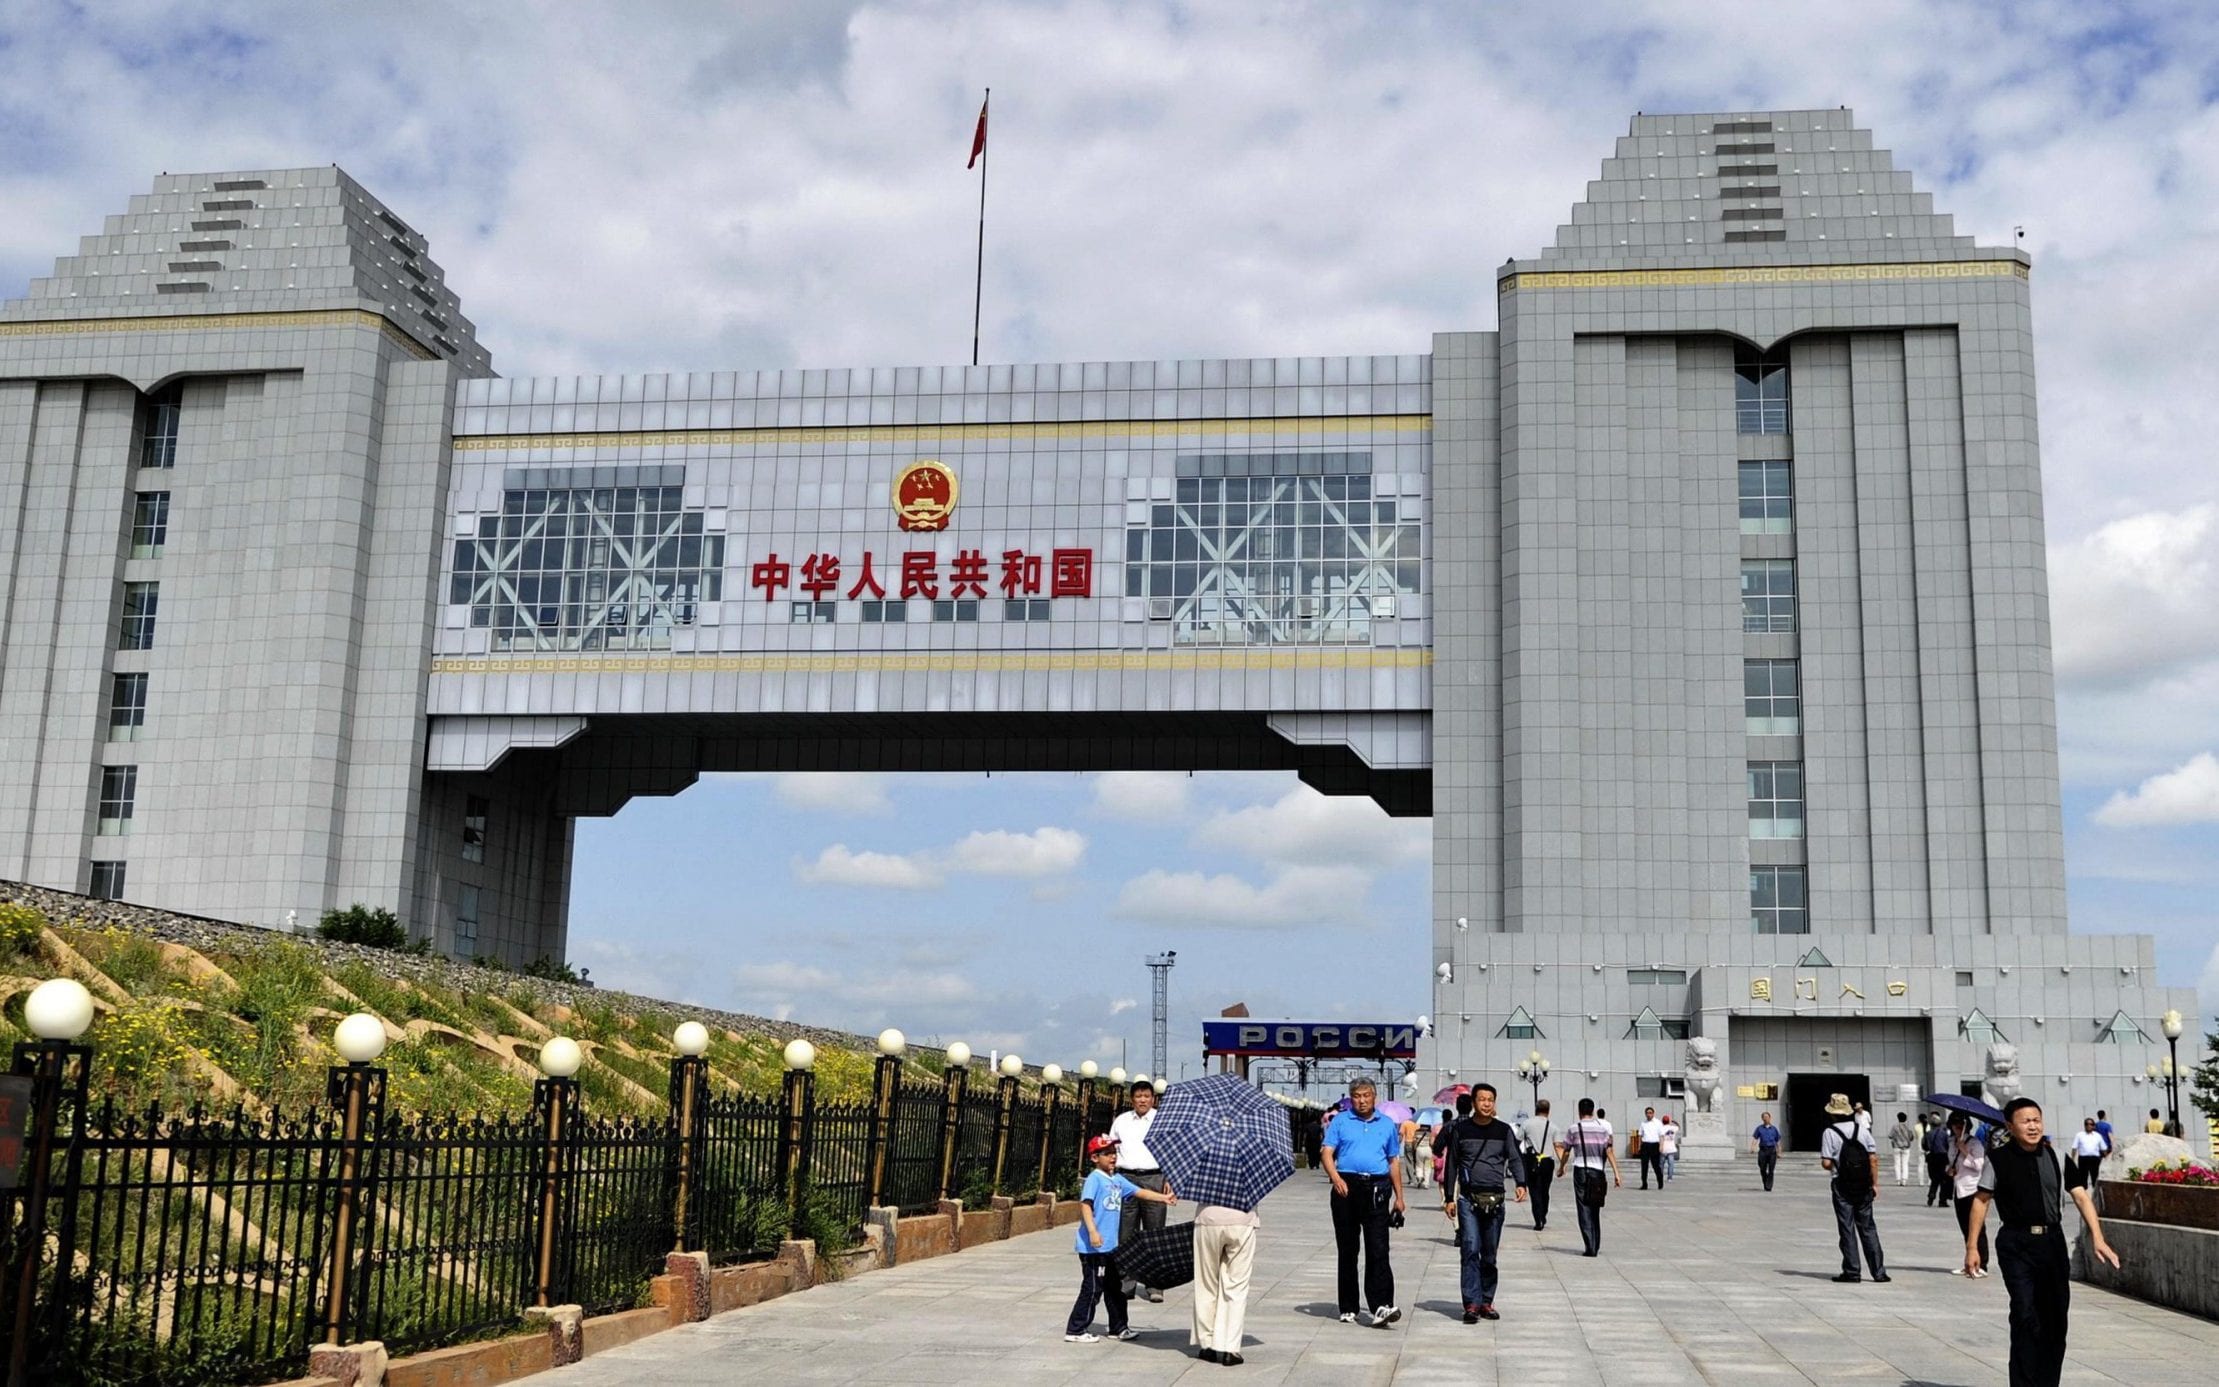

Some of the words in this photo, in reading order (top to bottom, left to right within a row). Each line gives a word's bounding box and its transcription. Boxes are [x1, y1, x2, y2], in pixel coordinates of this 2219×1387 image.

[752, 549, 1092, 601] 中华人民共和国
